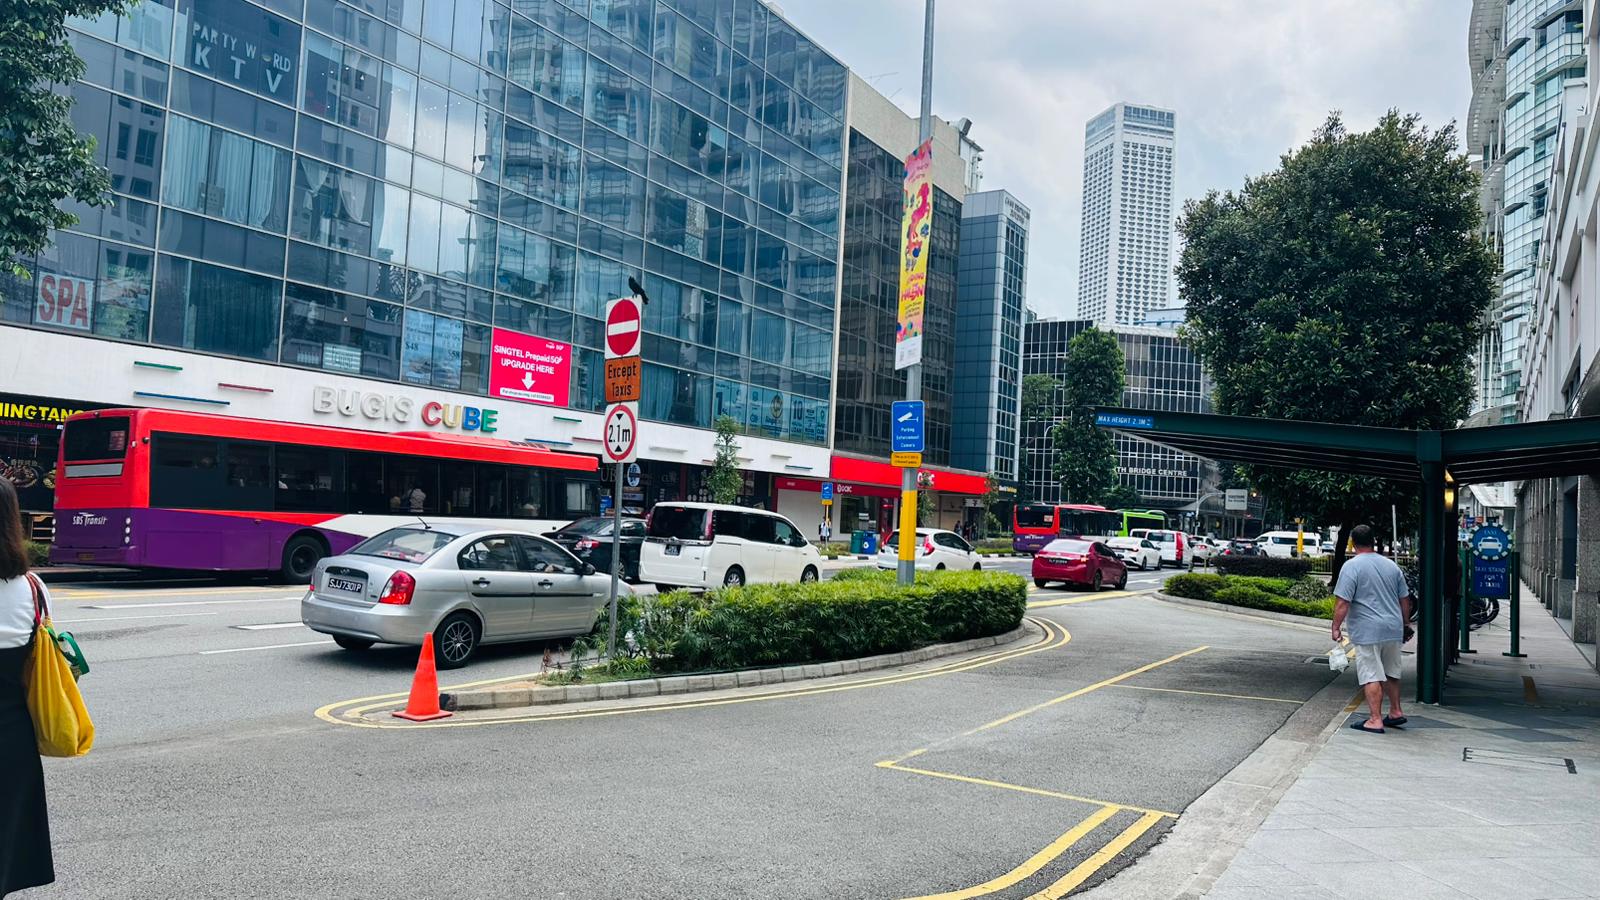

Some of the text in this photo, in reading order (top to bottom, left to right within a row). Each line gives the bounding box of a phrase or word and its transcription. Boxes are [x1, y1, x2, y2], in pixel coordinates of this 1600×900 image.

[193, 22, 237, 51] PARTY
[38, 274, 89, 327] SPA
[494, 345, 524, 358] SINGTEL
[525, 351, 550, 362] Prepaid
[501, 358, 555, 375] UPGRADE HERE
[608, 361, 637, 380] Except
[611, 381, 632, 397] Taxis
[313, 386, 499, 433] BUGIS CUBE
[608, 424, 631, 443] 2.1m
[1129, 467, 1156, 475] BRIDGE
[1159, 469, 1187, 477] CENTRE
[72, 512, 107, 526] SBS Transit
